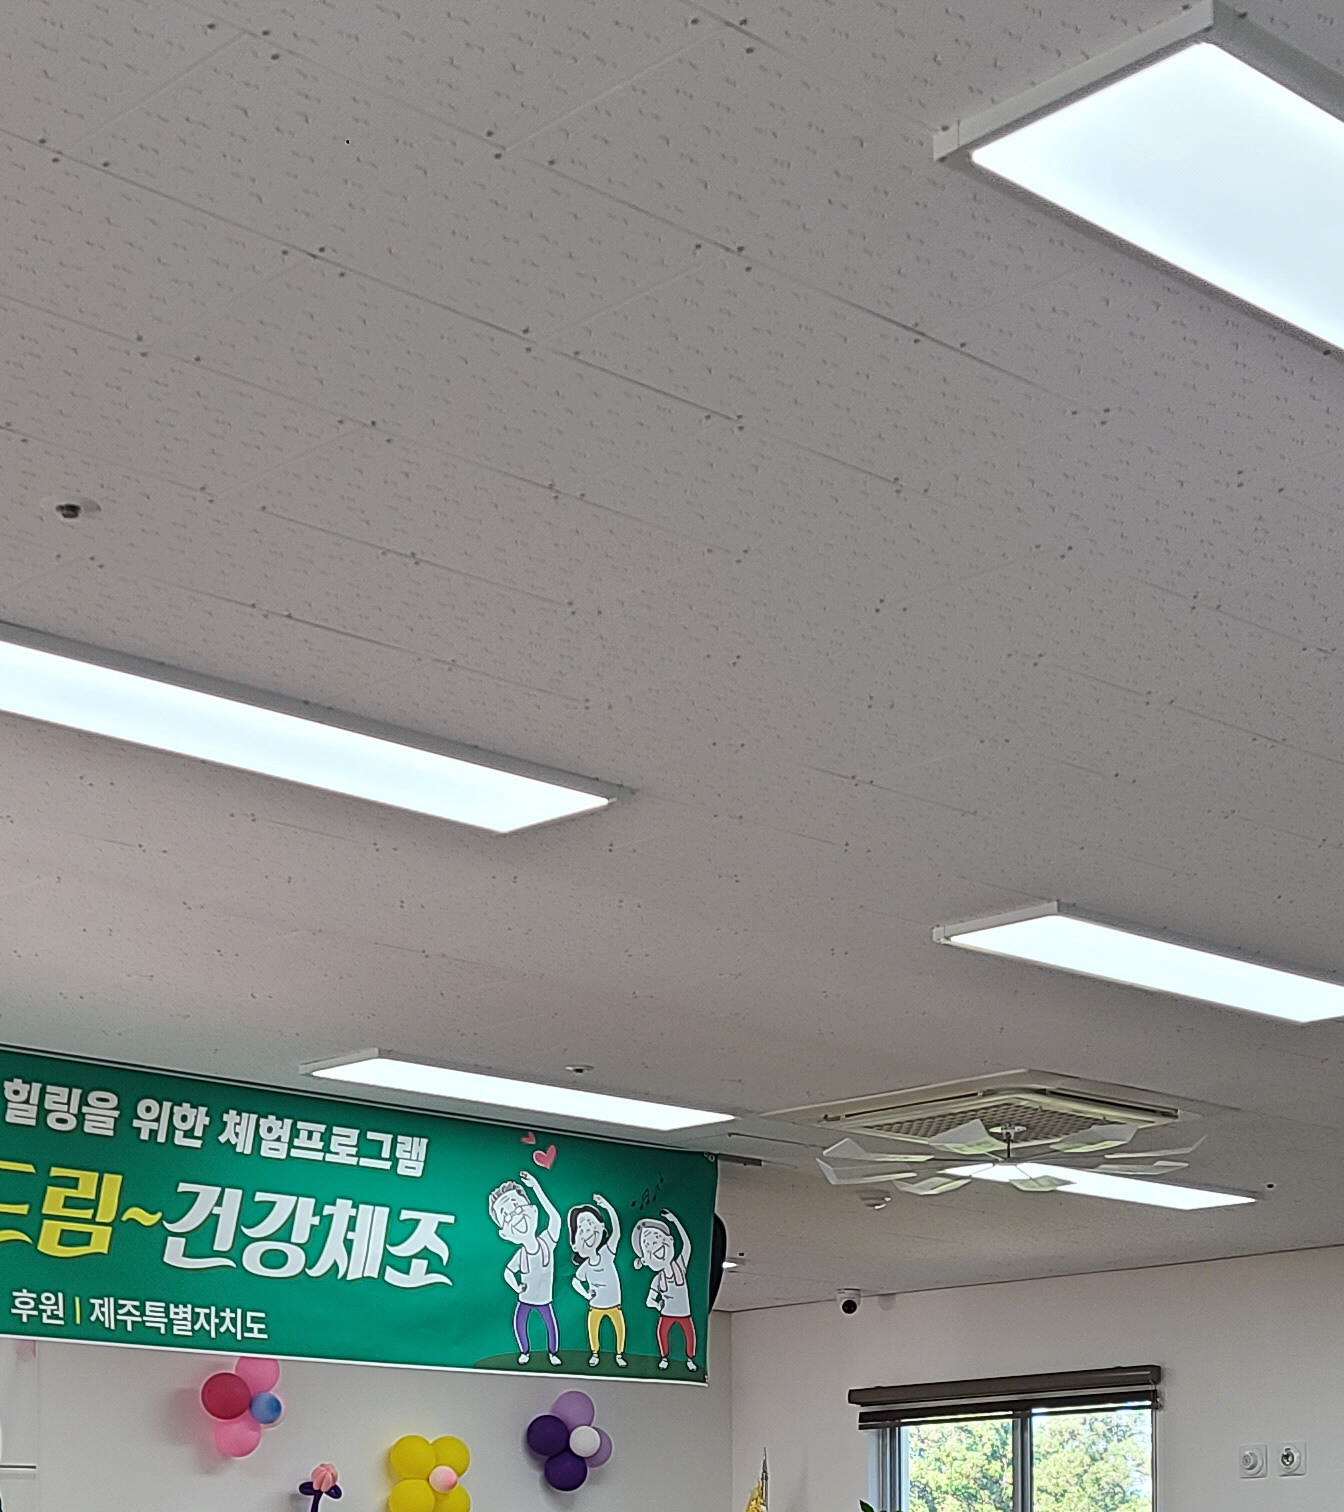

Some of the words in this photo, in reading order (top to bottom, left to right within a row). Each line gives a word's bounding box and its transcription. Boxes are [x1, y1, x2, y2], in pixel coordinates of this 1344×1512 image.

[3, 1079, 119, 1137] 힐링을
[133, 1098, 211, 1150] 위한
[219, 1110, 428, 1178] 체험프로그램
[10, 1287, 66, 1324] 후원
[89, 1297, 269, 1341] 제주특별자치도
